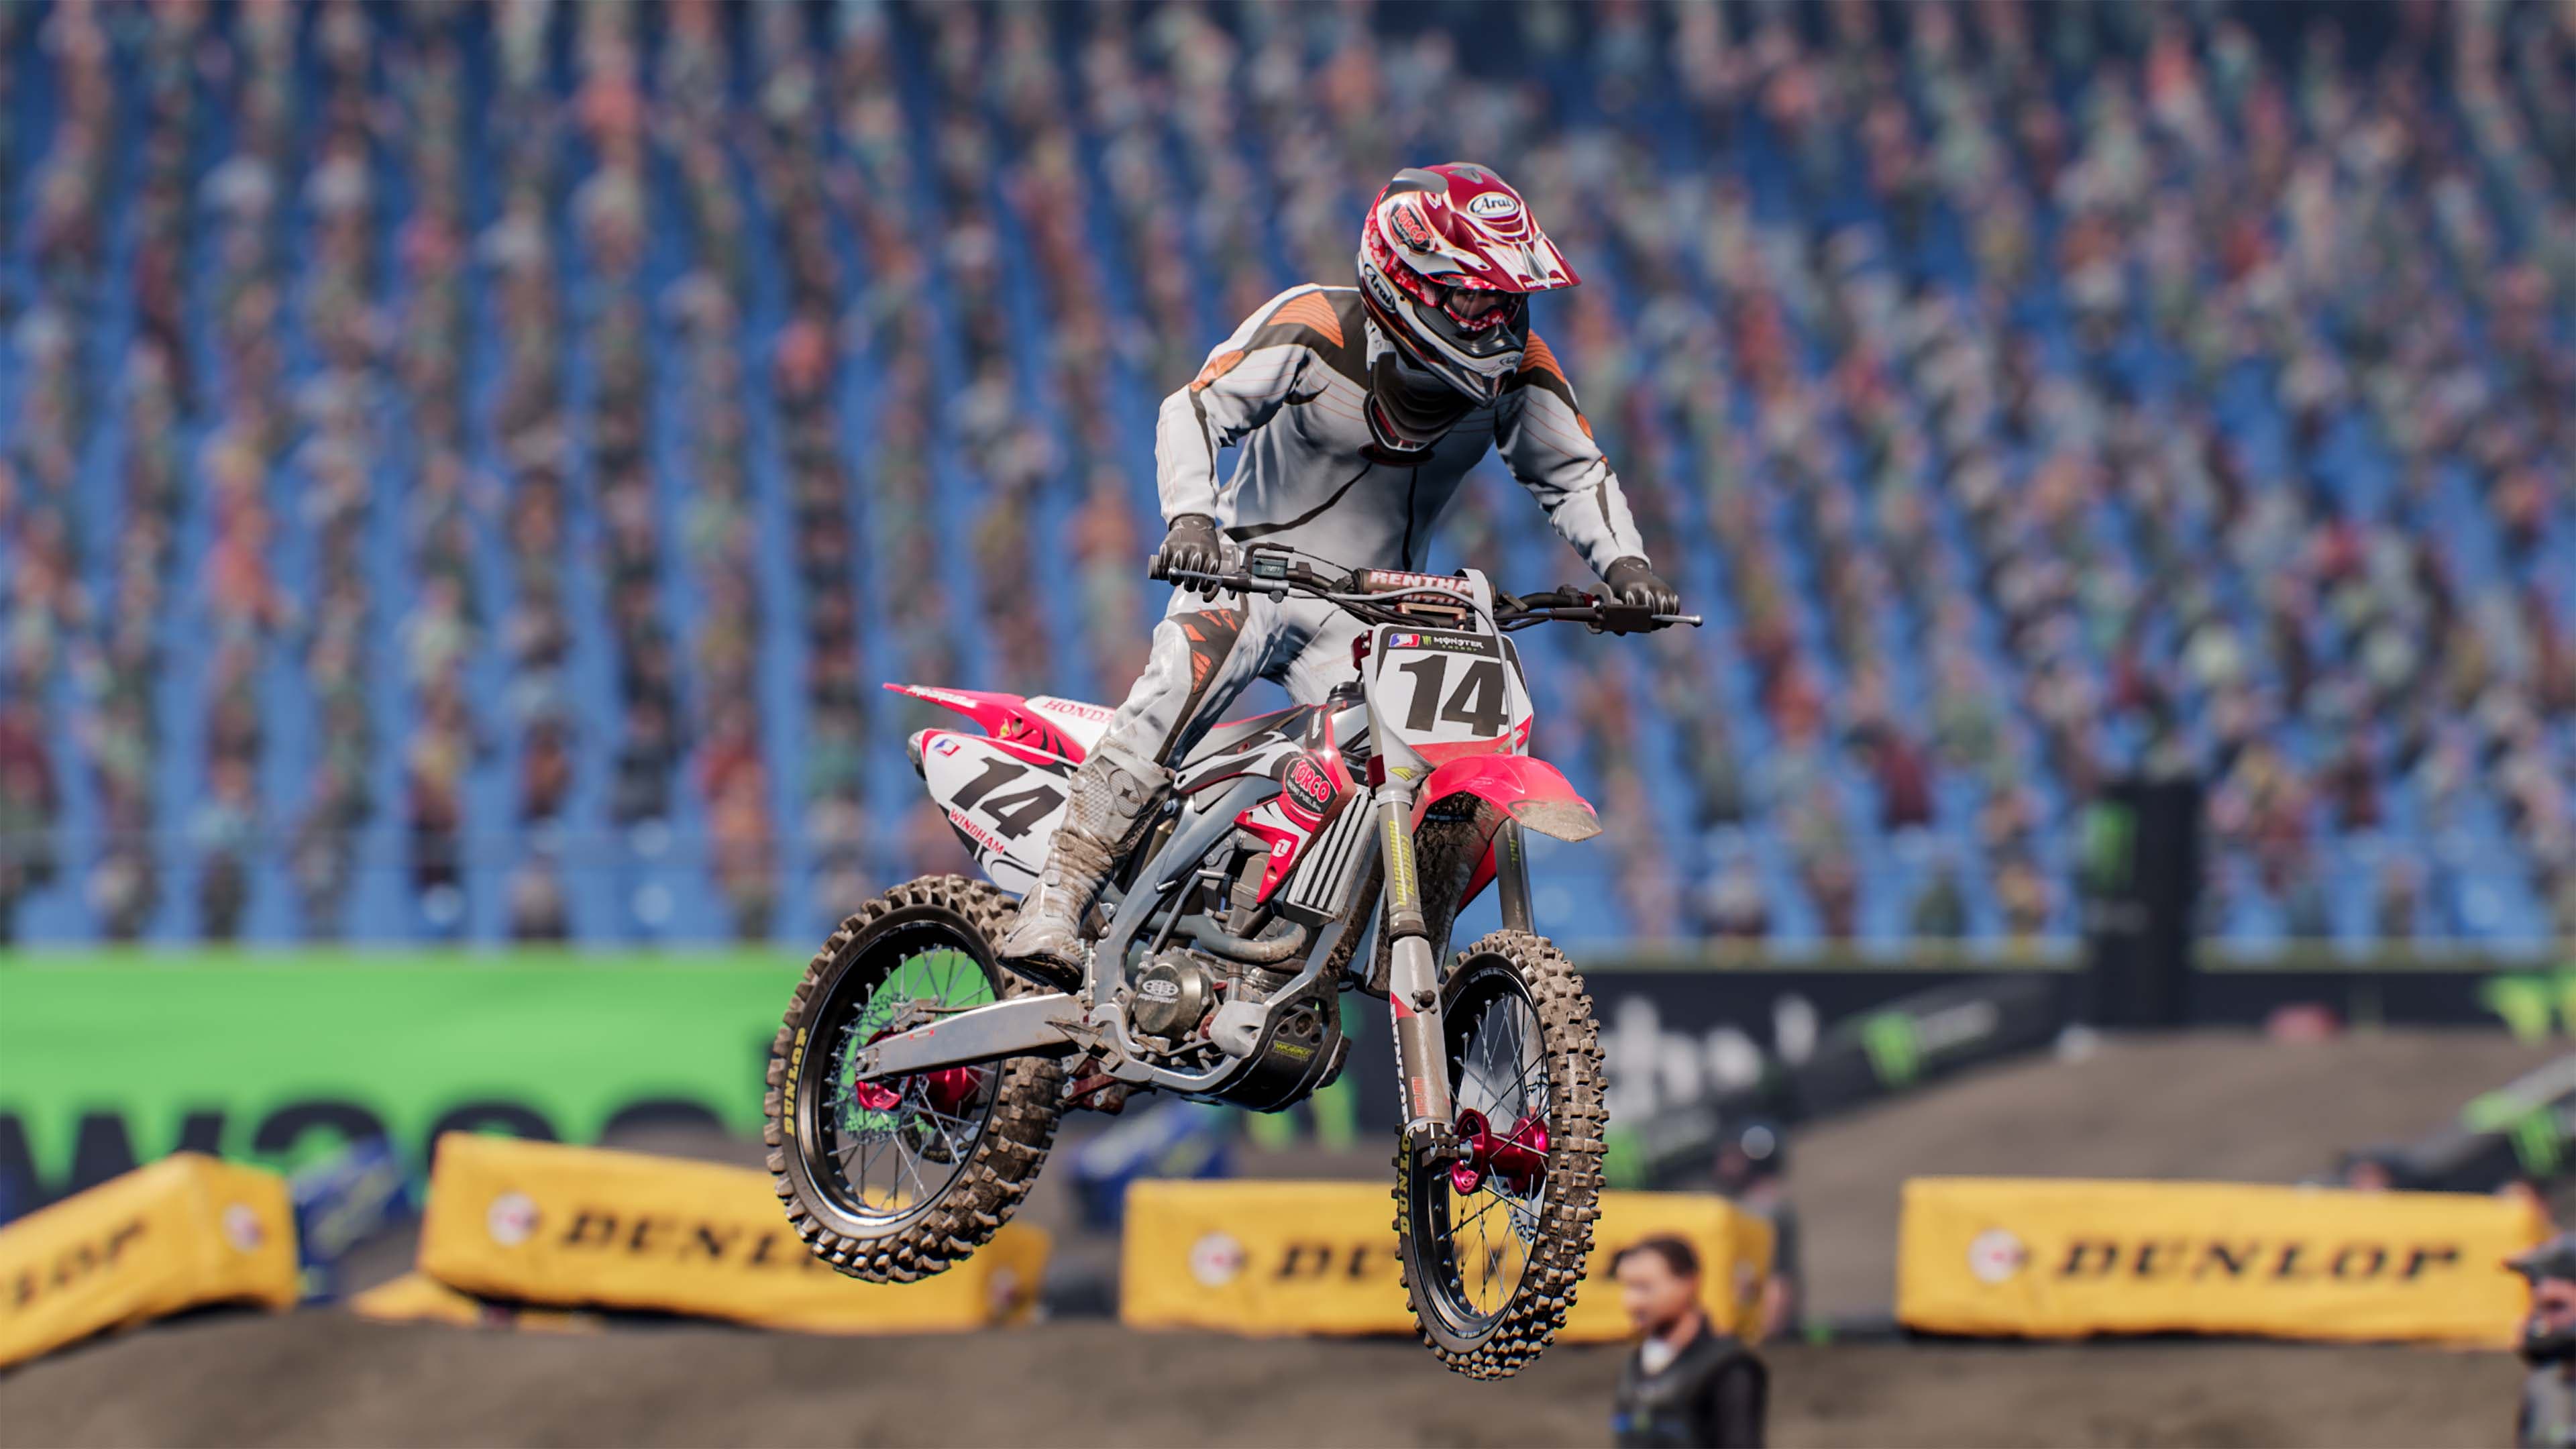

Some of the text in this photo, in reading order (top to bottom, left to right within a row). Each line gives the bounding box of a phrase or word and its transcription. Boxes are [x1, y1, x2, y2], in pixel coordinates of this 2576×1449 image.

[1395, 205, 1428, 244] TORCO
[1477, 197, 1511, 210] Arai
[1365, 273, 1393, 304] Arai
[1370, 570, 1474, 592] RENTHA
[1434, 636, 1484, 650] MONSTER
[1399, 654, 1509, 737] 14
[950, 757, 1066, 841] 14
[1291, 759, 1330, 803] TORCO
[949, 808, 1005, 855] WINDHAM
[784, 1027, 807, 1136] DUNLOP
[1398, 1132, 1411, 1236] DUNLO
[562, 1209, 805, 1268] DUNL
[2057, 1237, 2461, 1280] DUNLOP
